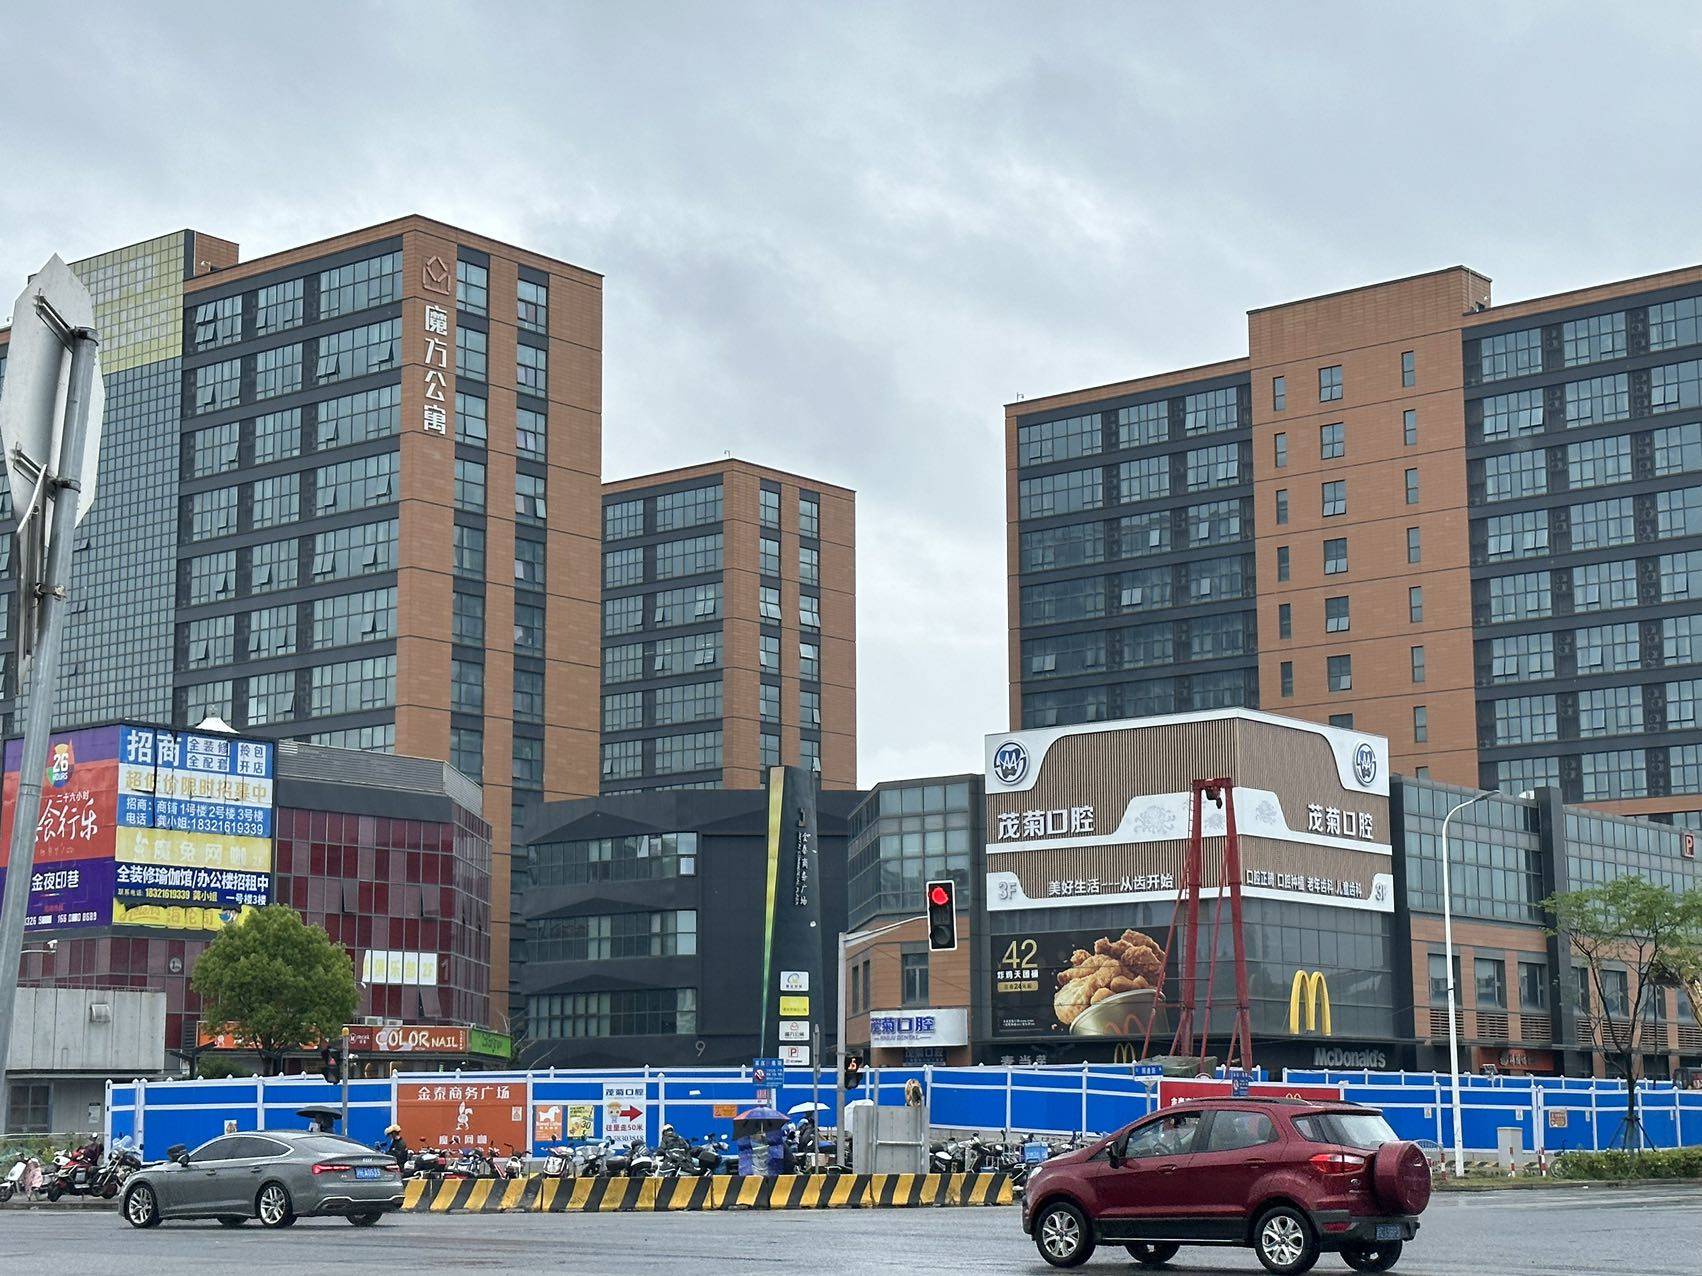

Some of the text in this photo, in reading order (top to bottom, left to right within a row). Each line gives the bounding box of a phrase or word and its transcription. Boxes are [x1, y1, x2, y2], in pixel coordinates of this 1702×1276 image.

[424, 304, 448, 435] 魔方公寓
[127, 729, 182, 766] 招商
[188, 738, 228, 756] 全装修
[53, 752, 68, 772] 26
[188, 754, 228, 770] 全配套
[239, 760, 263, 774] 开店
[126, 812, 146, 825] 电话
[157, 800, 178, 814] 商铺
[180, 804, 206, 818] 1号楼
[209, 806, 236, 820] 2号楼
[238, 808, 264, 823] 3号楼
[998, 804, 1095, 839] 茂菊口腔
[1307, 803, 1374, 840] 茂菊口腔
[31, 870, 80, 892] 金夜印巷
[116, 864, 269, 892] 全装修瑜伽馆/办公楼招租中
[1246, 870, 1274, 887] 口腔正畸
[1307, 876, 1334, 893] 老年齿科
[1336, 880, 1362, 898] 儿童齿科
[146, 888, 190, 900] 18321619339
[226, 893, 266, 906] 一号楼3楼
[998, 881, 1018, 900] 3F
[1002, 938, 1038, 969] 42
[376, 1030, 430, 1048] COLOR
[432, 1037, 458, 1048] NAIL
[696, 1040, 706, 1056] 9
[1313, 1047, 1386, 1068] McDonald's
[418, 1086, 510, 1100] 金泰商务广场
